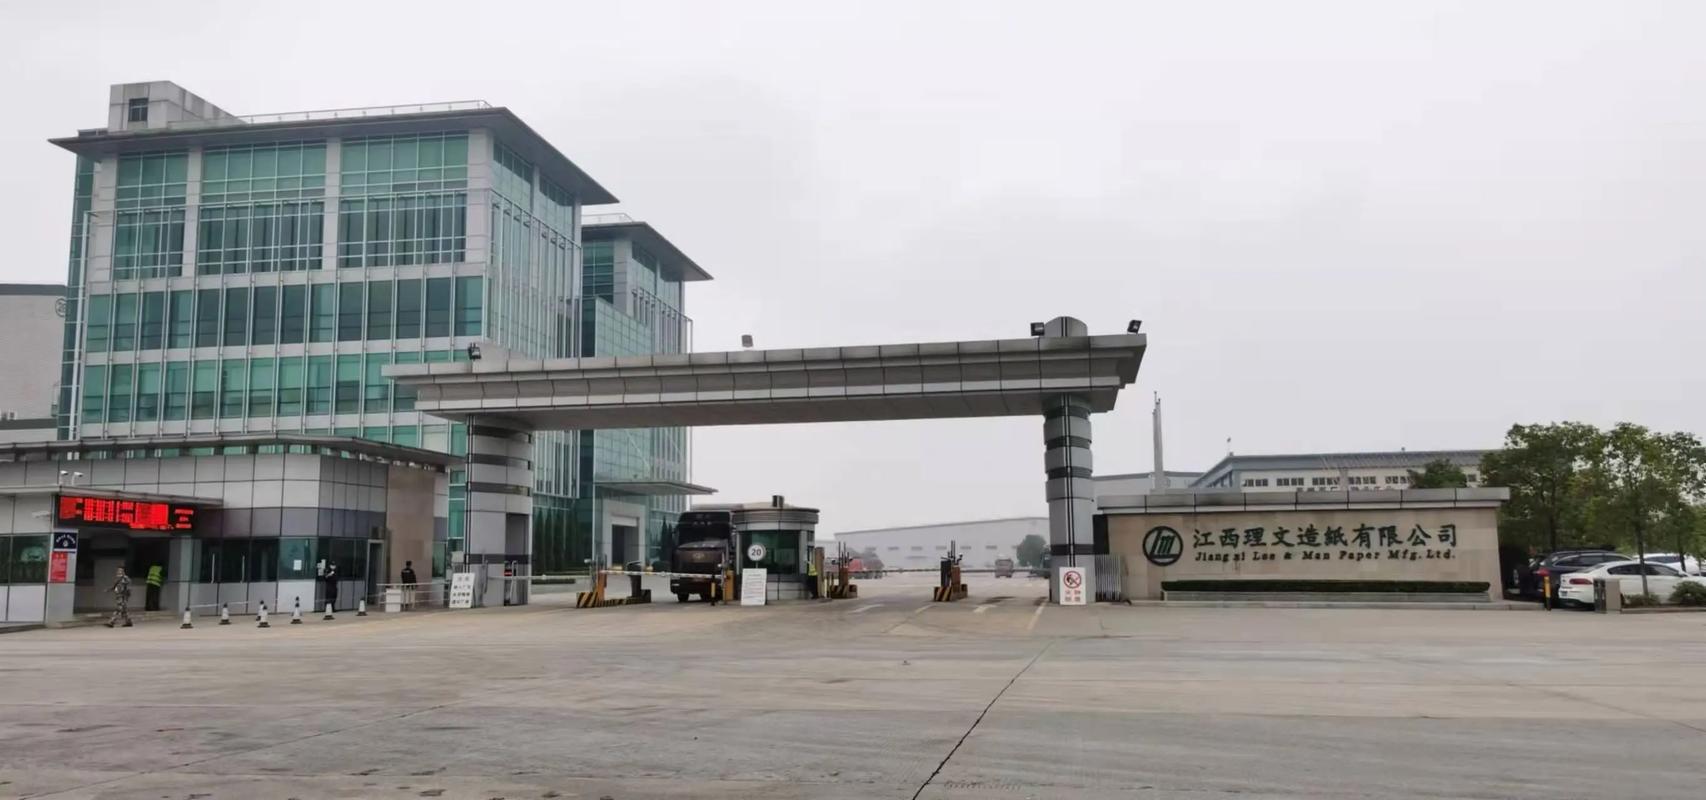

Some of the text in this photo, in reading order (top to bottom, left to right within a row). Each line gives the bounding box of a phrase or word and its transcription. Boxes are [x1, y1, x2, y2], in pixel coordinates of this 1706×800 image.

[1193, 523, 1458, 549] 江西理文造紙有限公司
[751, 548, 762, 557] 20
[1252, 551, 1276, 561] Lee
[1301, 550, 1331, 561] Man
[1338, 550, 1381, 562] Paper
[1426, 549, 1456, 560] Ltd.
